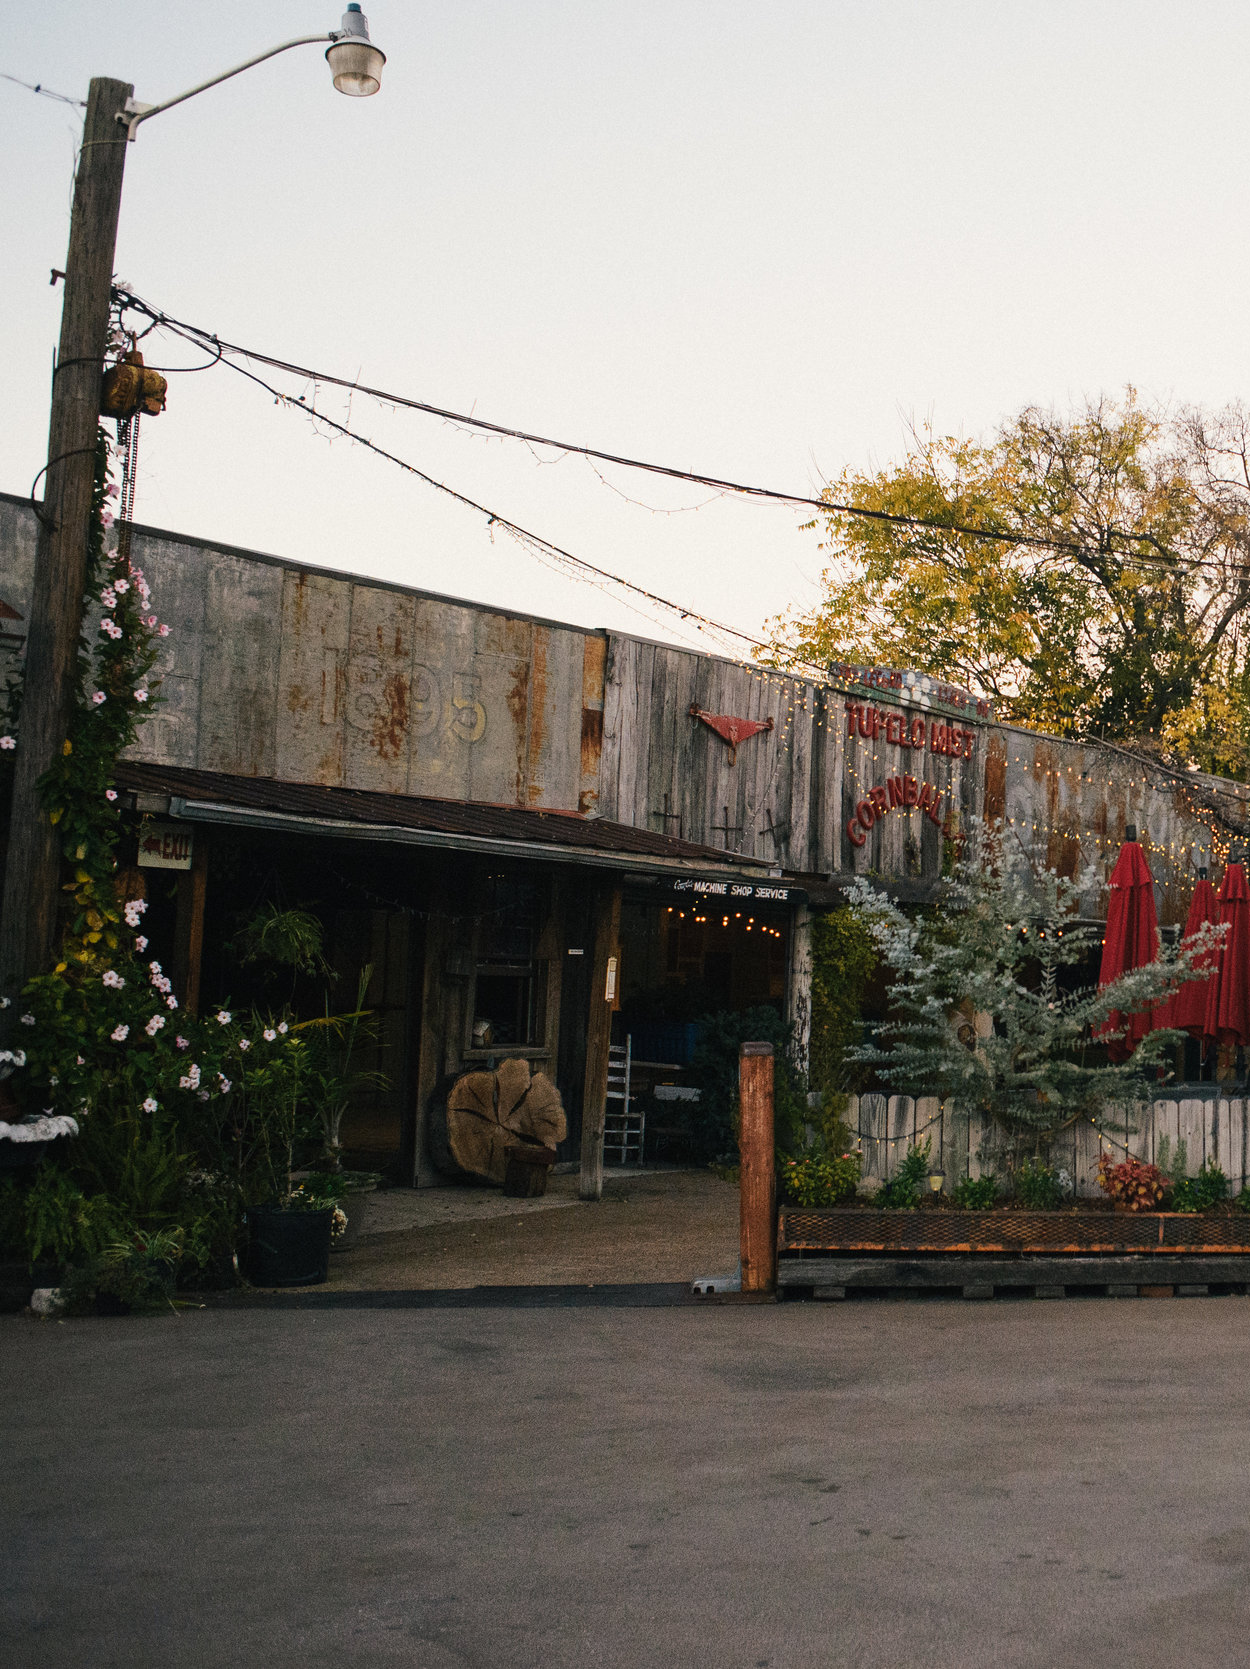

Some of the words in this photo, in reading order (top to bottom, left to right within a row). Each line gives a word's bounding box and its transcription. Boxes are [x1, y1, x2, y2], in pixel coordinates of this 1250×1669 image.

[320, 647, 487, 744] 1895
[844, 701, 925, 750] TUPELO
[931, 721, 976, 760] MIST
[162, 832, 190, 861] EXIT
[694, 881, 728, 895] MACHINE
[730, 884, 753, 897] SHOP
[754, 887, 789, 900] SERVICE
